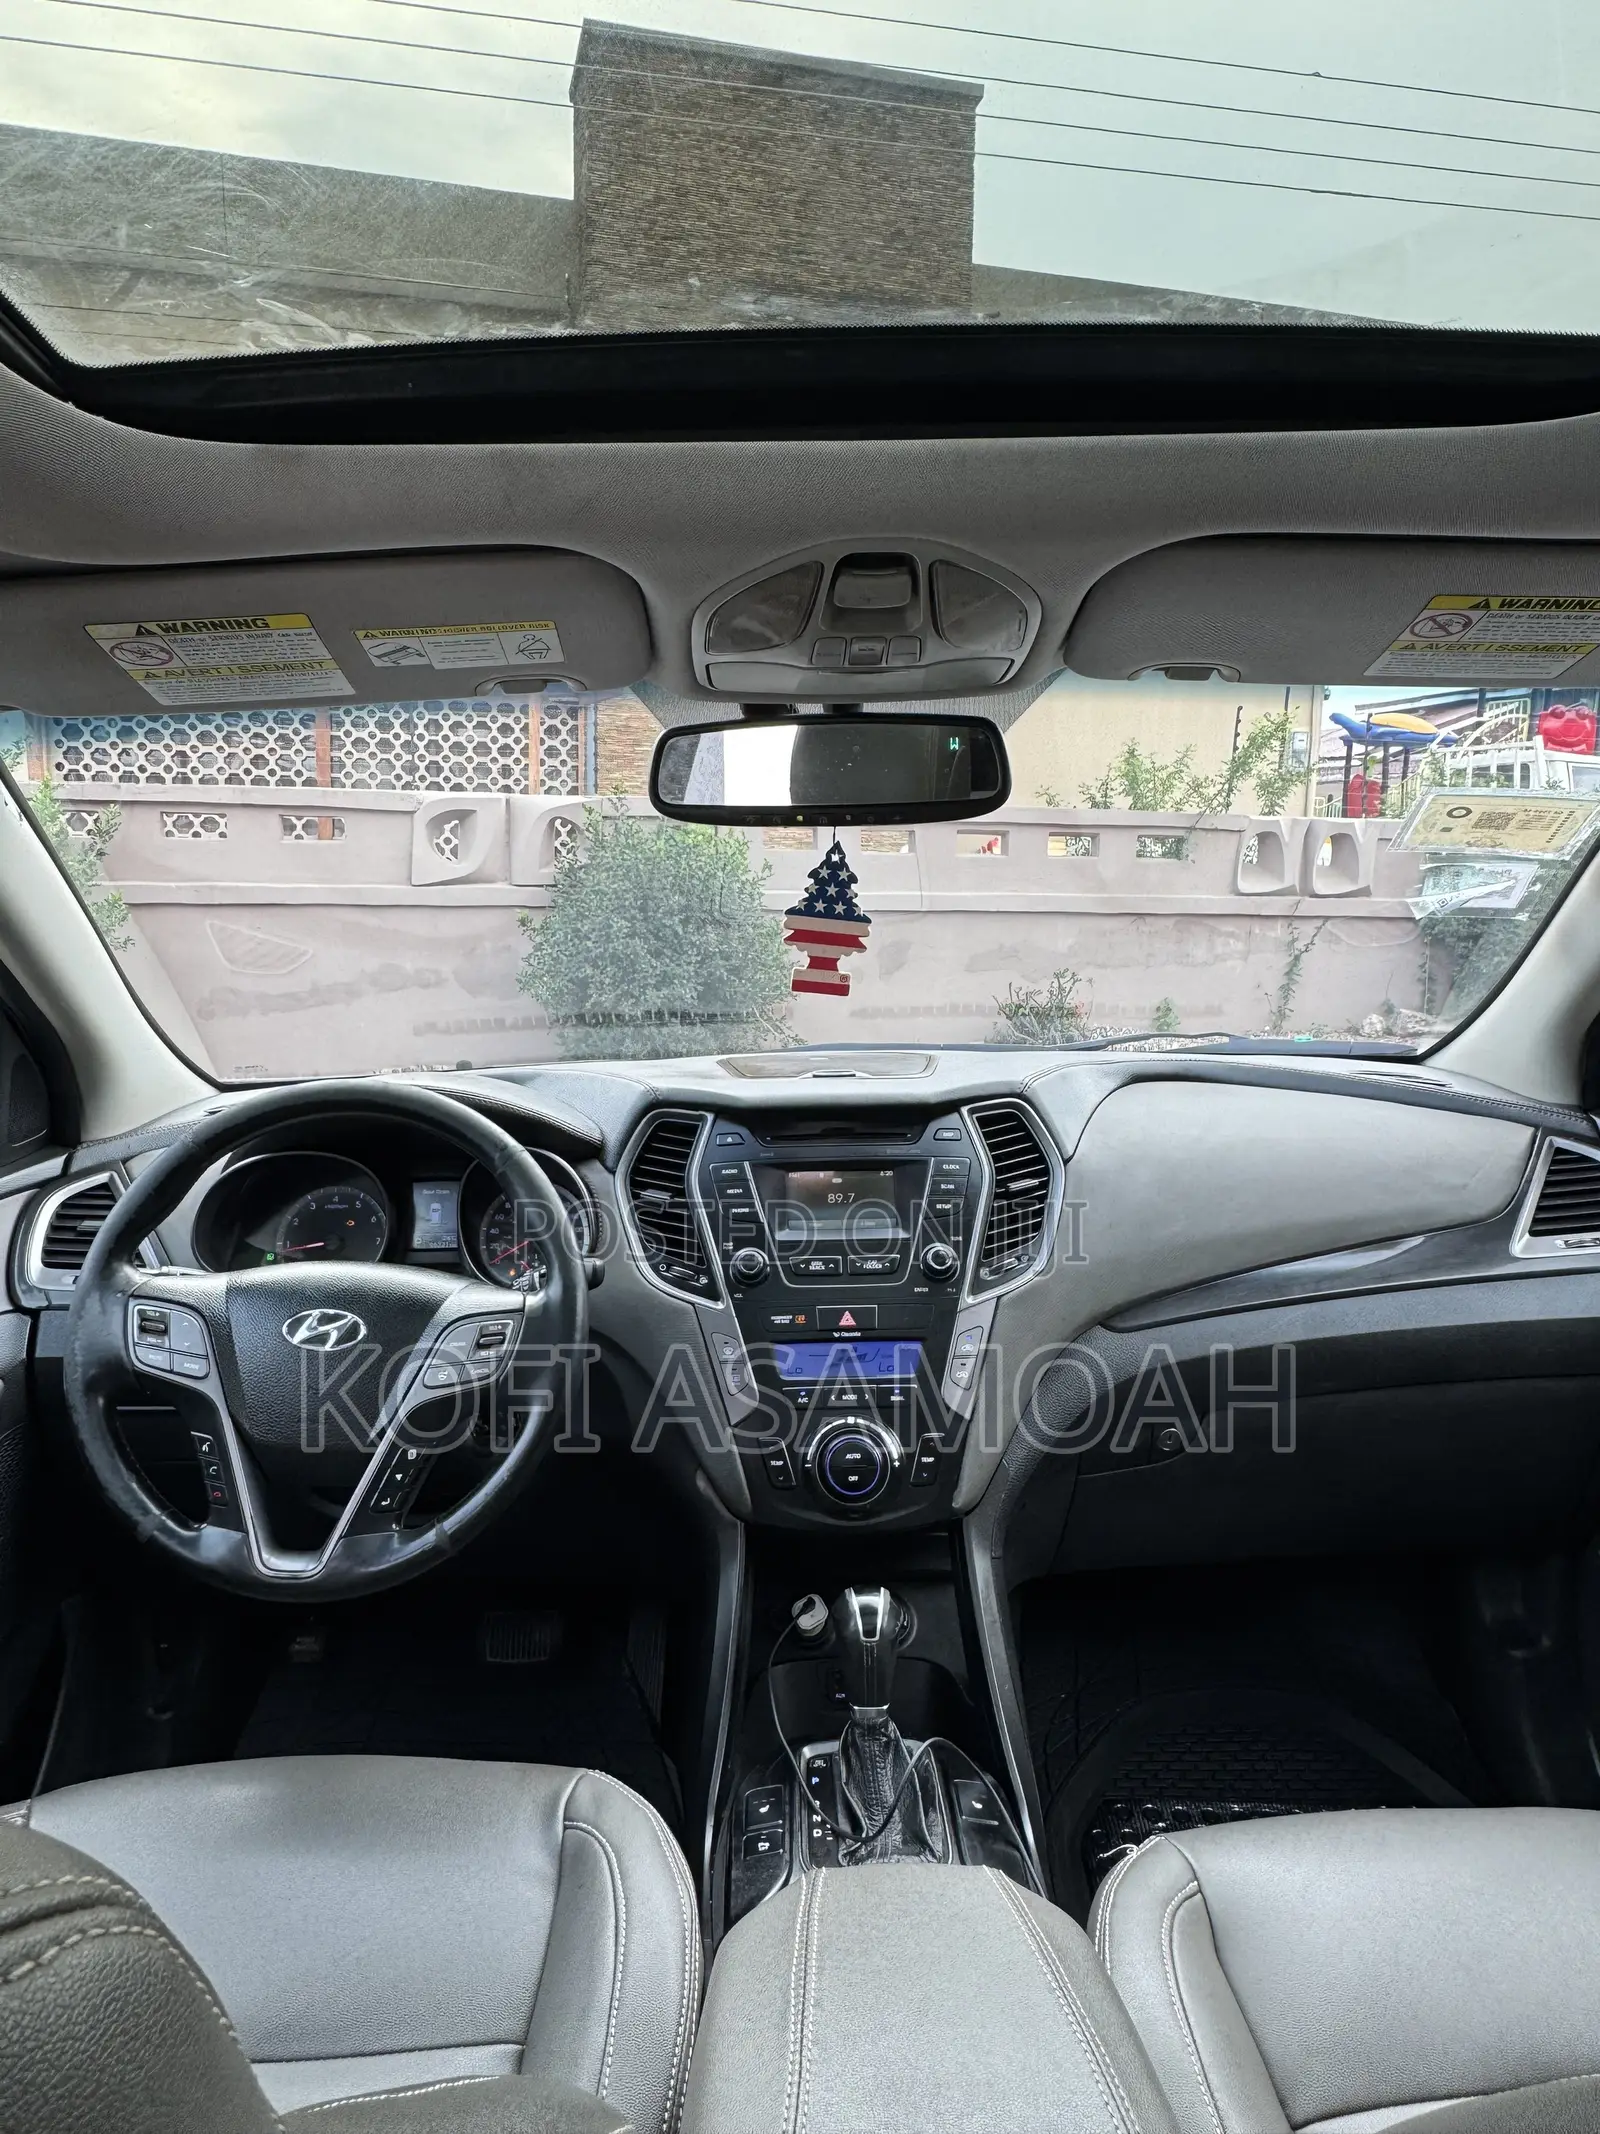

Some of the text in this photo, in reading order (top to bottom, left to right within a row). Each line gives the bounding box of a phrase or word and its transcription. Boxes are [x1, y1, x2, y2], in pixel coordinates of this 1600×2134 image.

[157, 617, 270, 635] WARNING
[950, 736, 959, 750] W
[827, 1193, 856, 1204] 89.7
[812, 1814, 822, 1822] N
[812, 1828, 823, 1838] D
